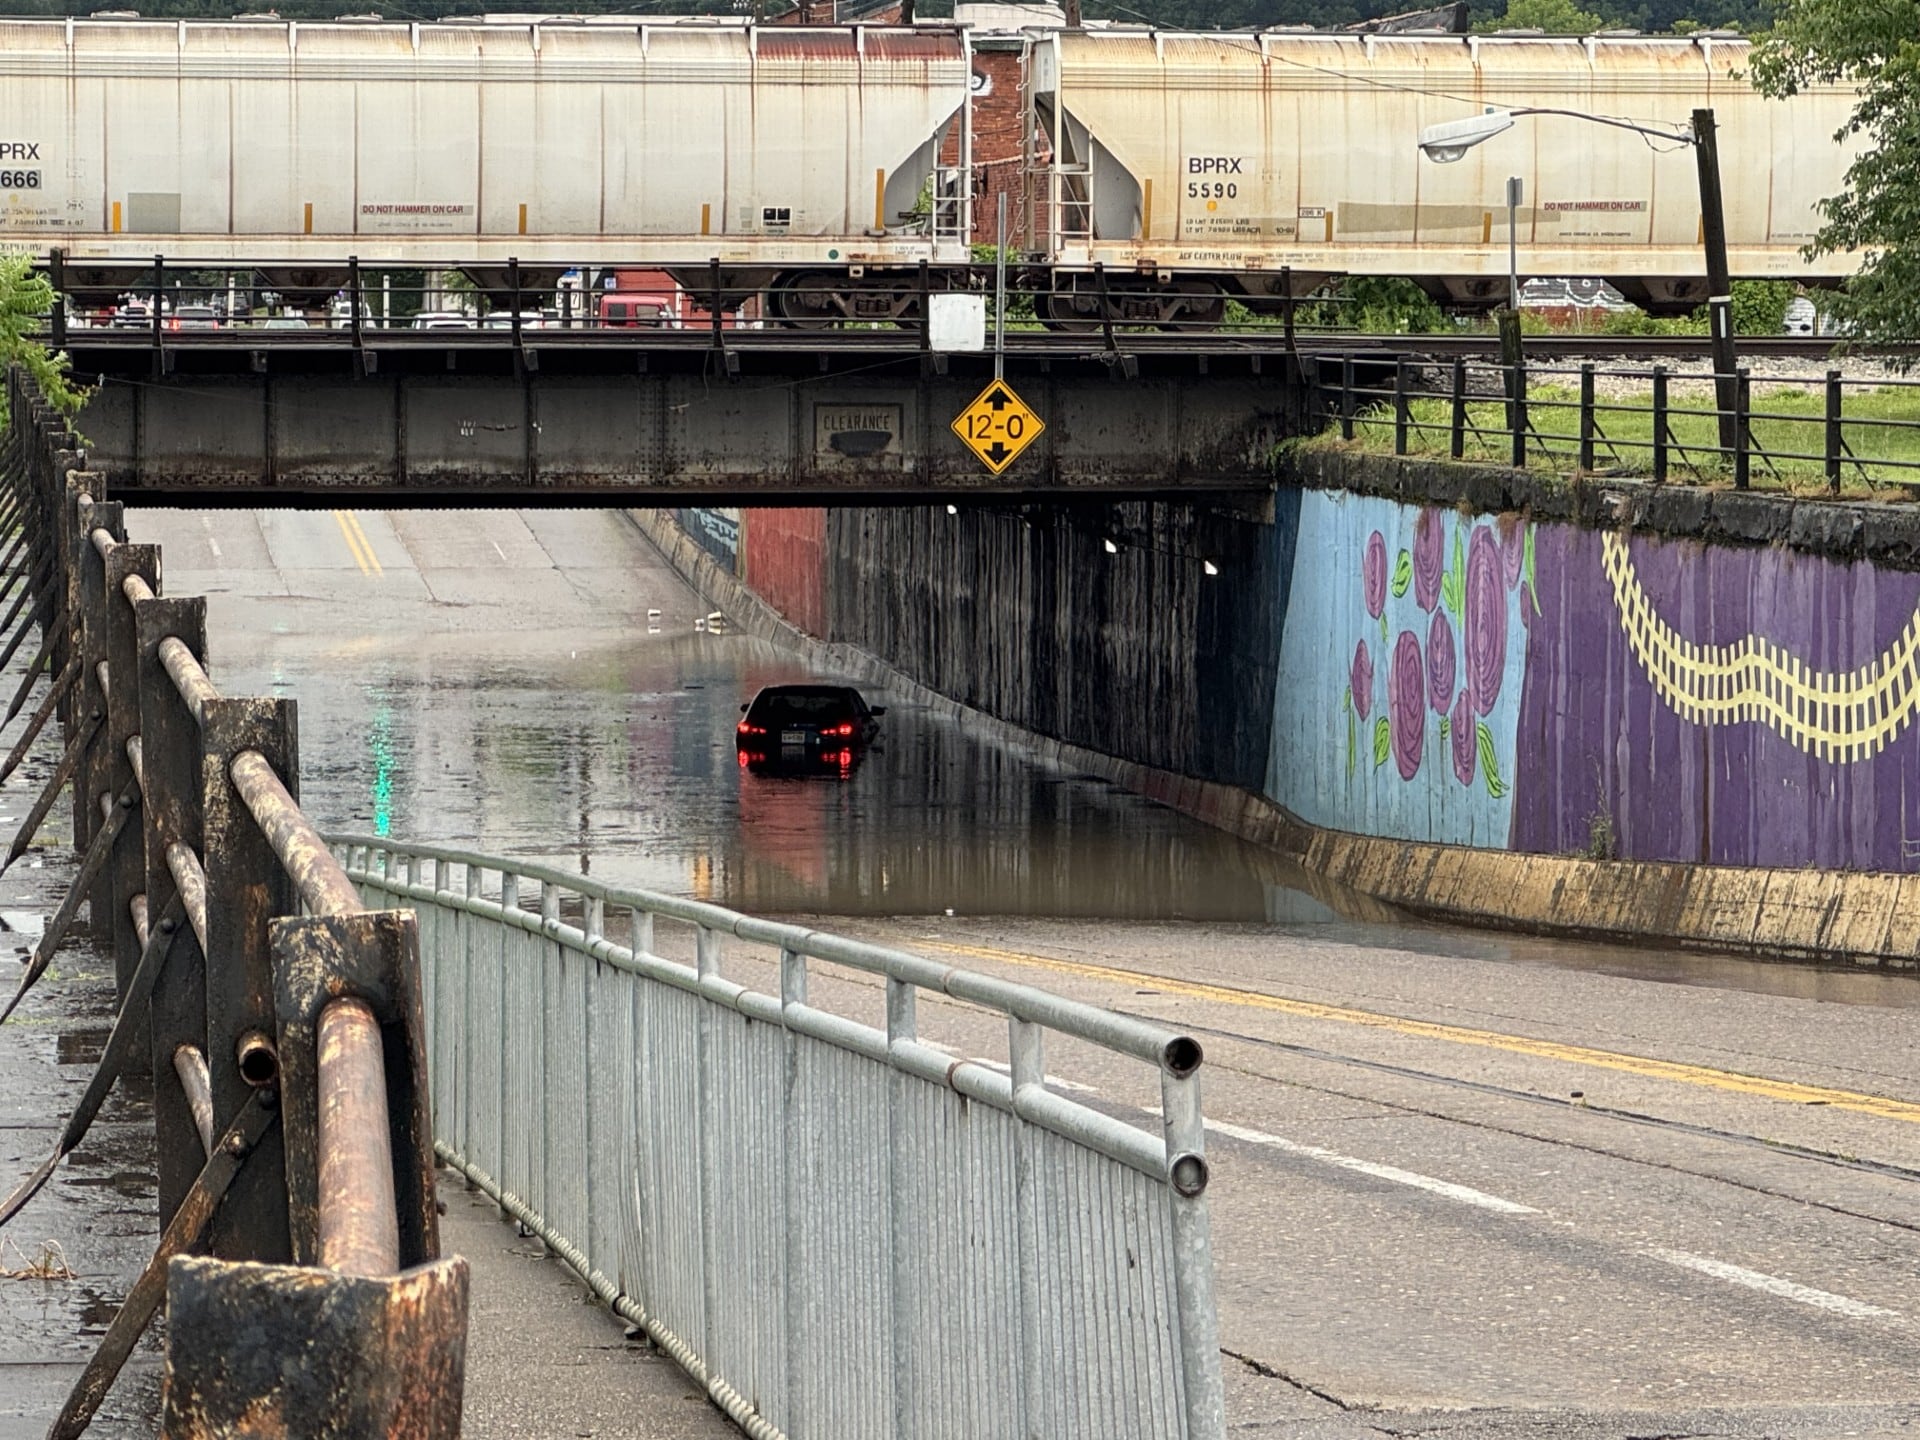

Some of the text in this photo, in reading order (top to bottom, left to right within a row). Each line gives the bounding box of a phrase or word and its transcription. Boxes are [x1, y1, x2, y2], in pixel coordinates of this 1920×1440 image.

[0, 143, 40, 160] PRX
[1189, 157, 1242, 174] BPRX
[1, 171, 39, 188] 666
[1188, 182, 1237, 199] 5590
[362, 204, 464, 214] DO NOT HAMMER ON CAR
[1544, 201, 1640, 211] DO NOT HAMMER ON CAR
[823, 414, 890, 430] CLEARANCE
